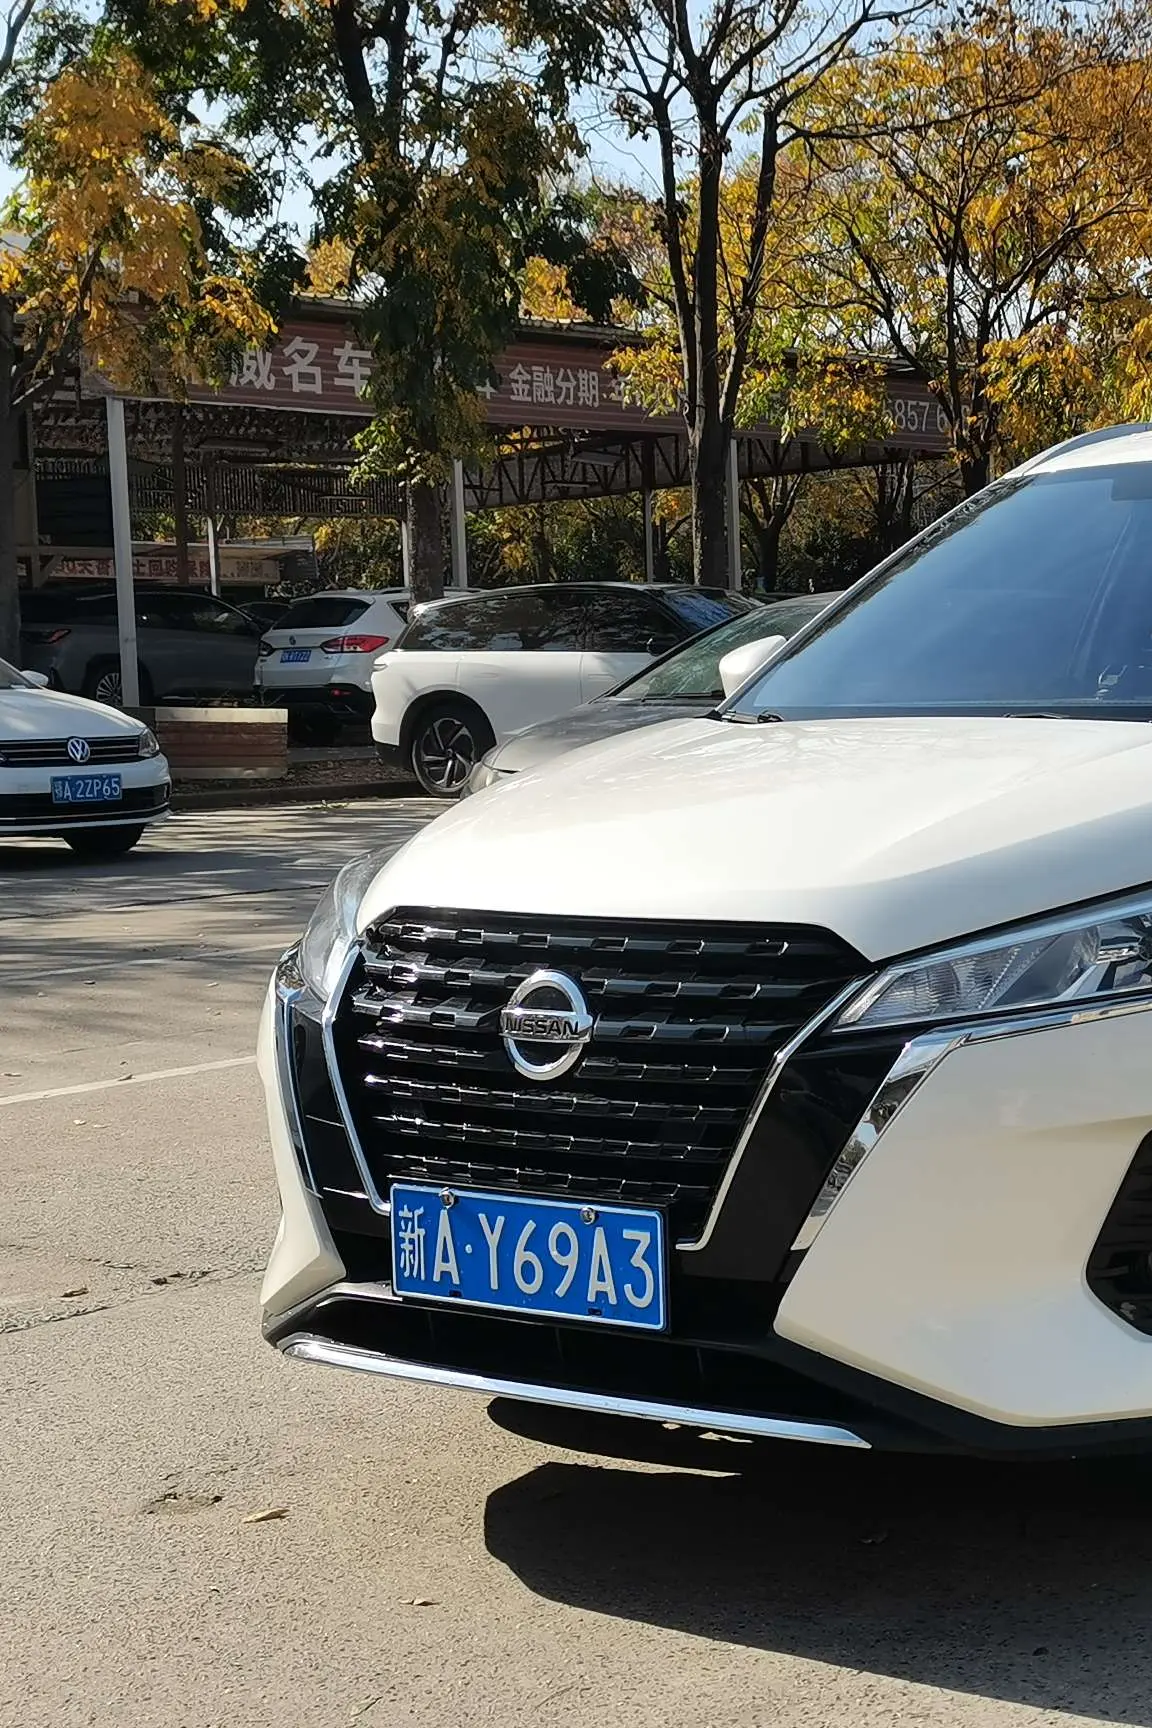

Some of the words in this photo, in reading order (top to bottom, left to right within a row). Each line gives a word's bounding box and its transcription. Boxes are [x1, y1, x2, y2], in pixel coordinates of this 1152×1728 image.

[509, 362, 599, 408] 金融分期
[505, 1017, 580, 1036] NISSAN
[398, 1204, 655, 1309] 新A·Y69A3
